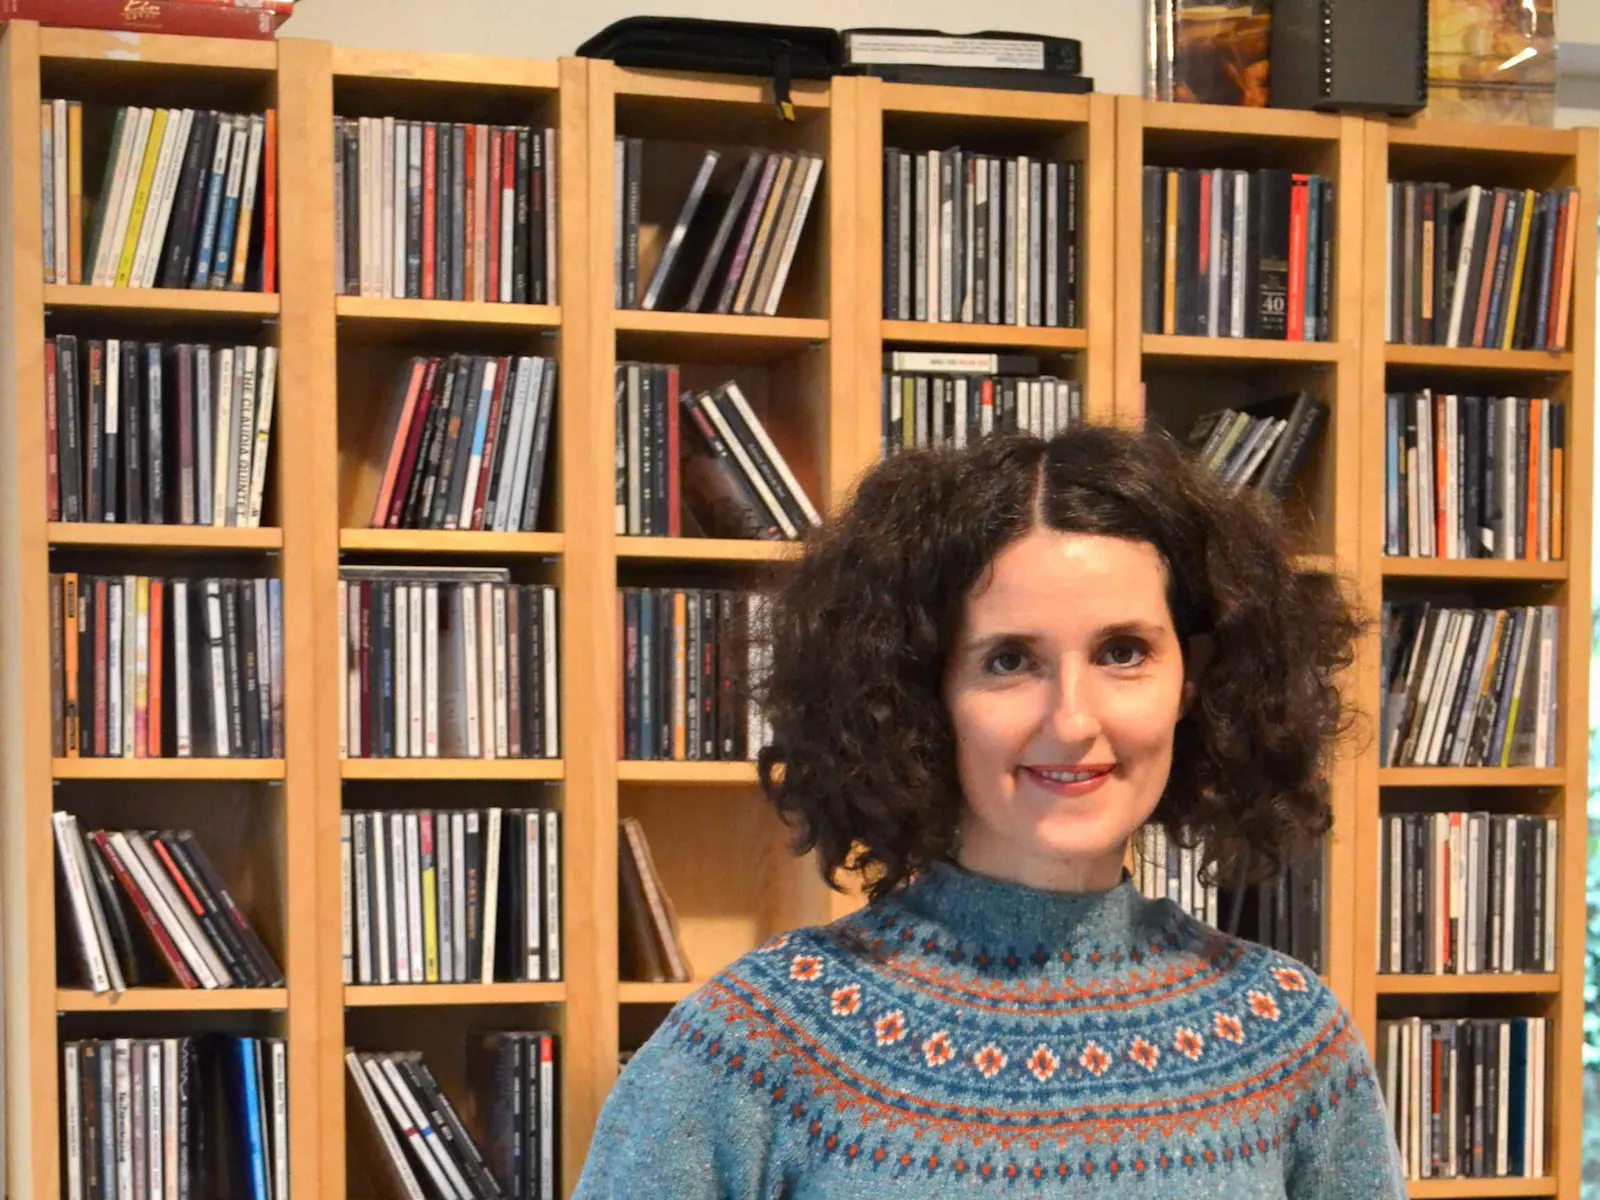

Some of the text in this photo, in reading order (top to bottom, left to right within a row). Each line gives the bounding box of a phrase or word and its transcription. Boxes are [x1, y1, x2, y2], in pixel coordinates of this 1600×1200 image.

[1262, 296, 1285, 312] 40
[235, 370, 253, 515] THE CLAUDIA QUINTET
